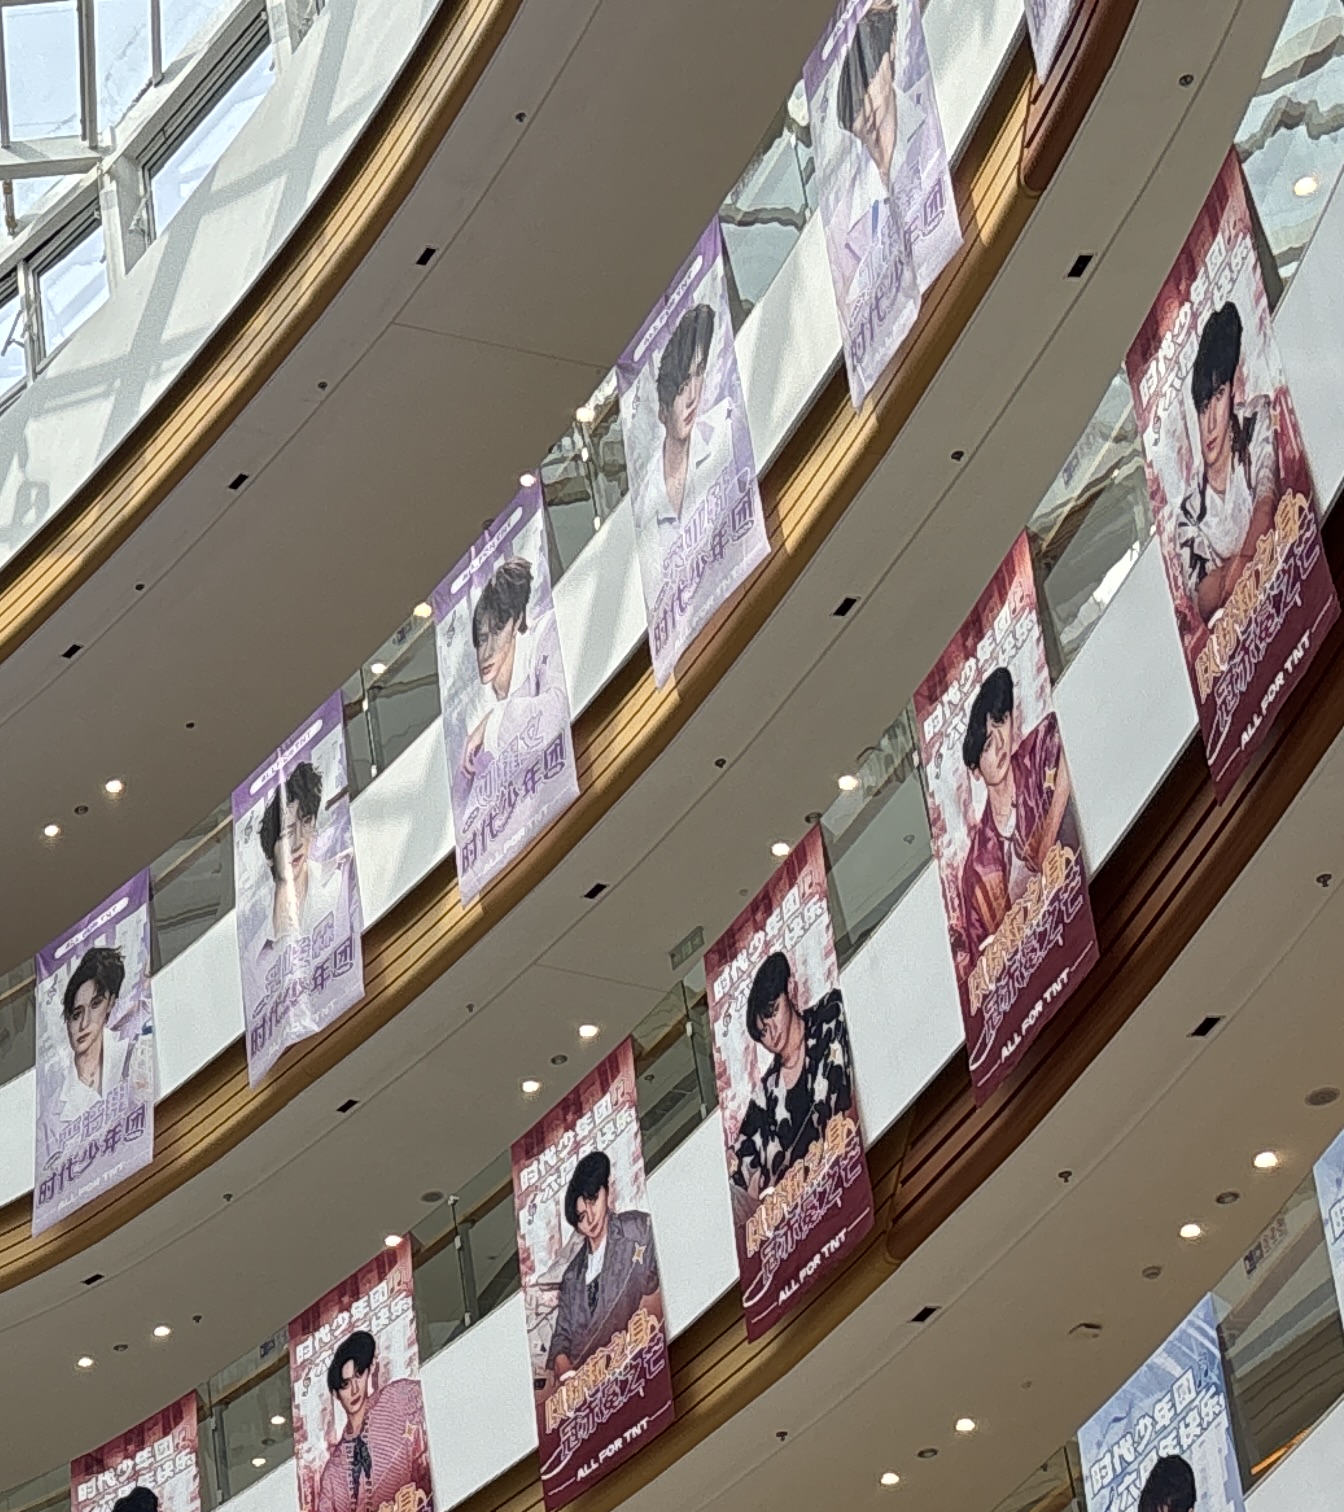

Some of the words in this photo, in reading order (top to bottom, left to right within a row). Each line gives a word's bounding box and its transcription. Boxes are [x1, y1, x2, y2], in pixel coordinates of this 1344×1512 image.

[461, 731, 565, 870] 时代少年团
[1000, 1028, 1022, 1064] ALL
[1022, 998, 1045, 1035] FOR
[1046, 965, 1070, 1003] TNT
[40, 1104, 144, 1203] 时代少年团
[520, 1097, 613, 1189] 时代少年团
[295, 1285, 387, 1365] 时代少年团
[79, 1436, 172, 1502] 时代少年团
[1090, 1371, 1196, 1495] 时代少年团
